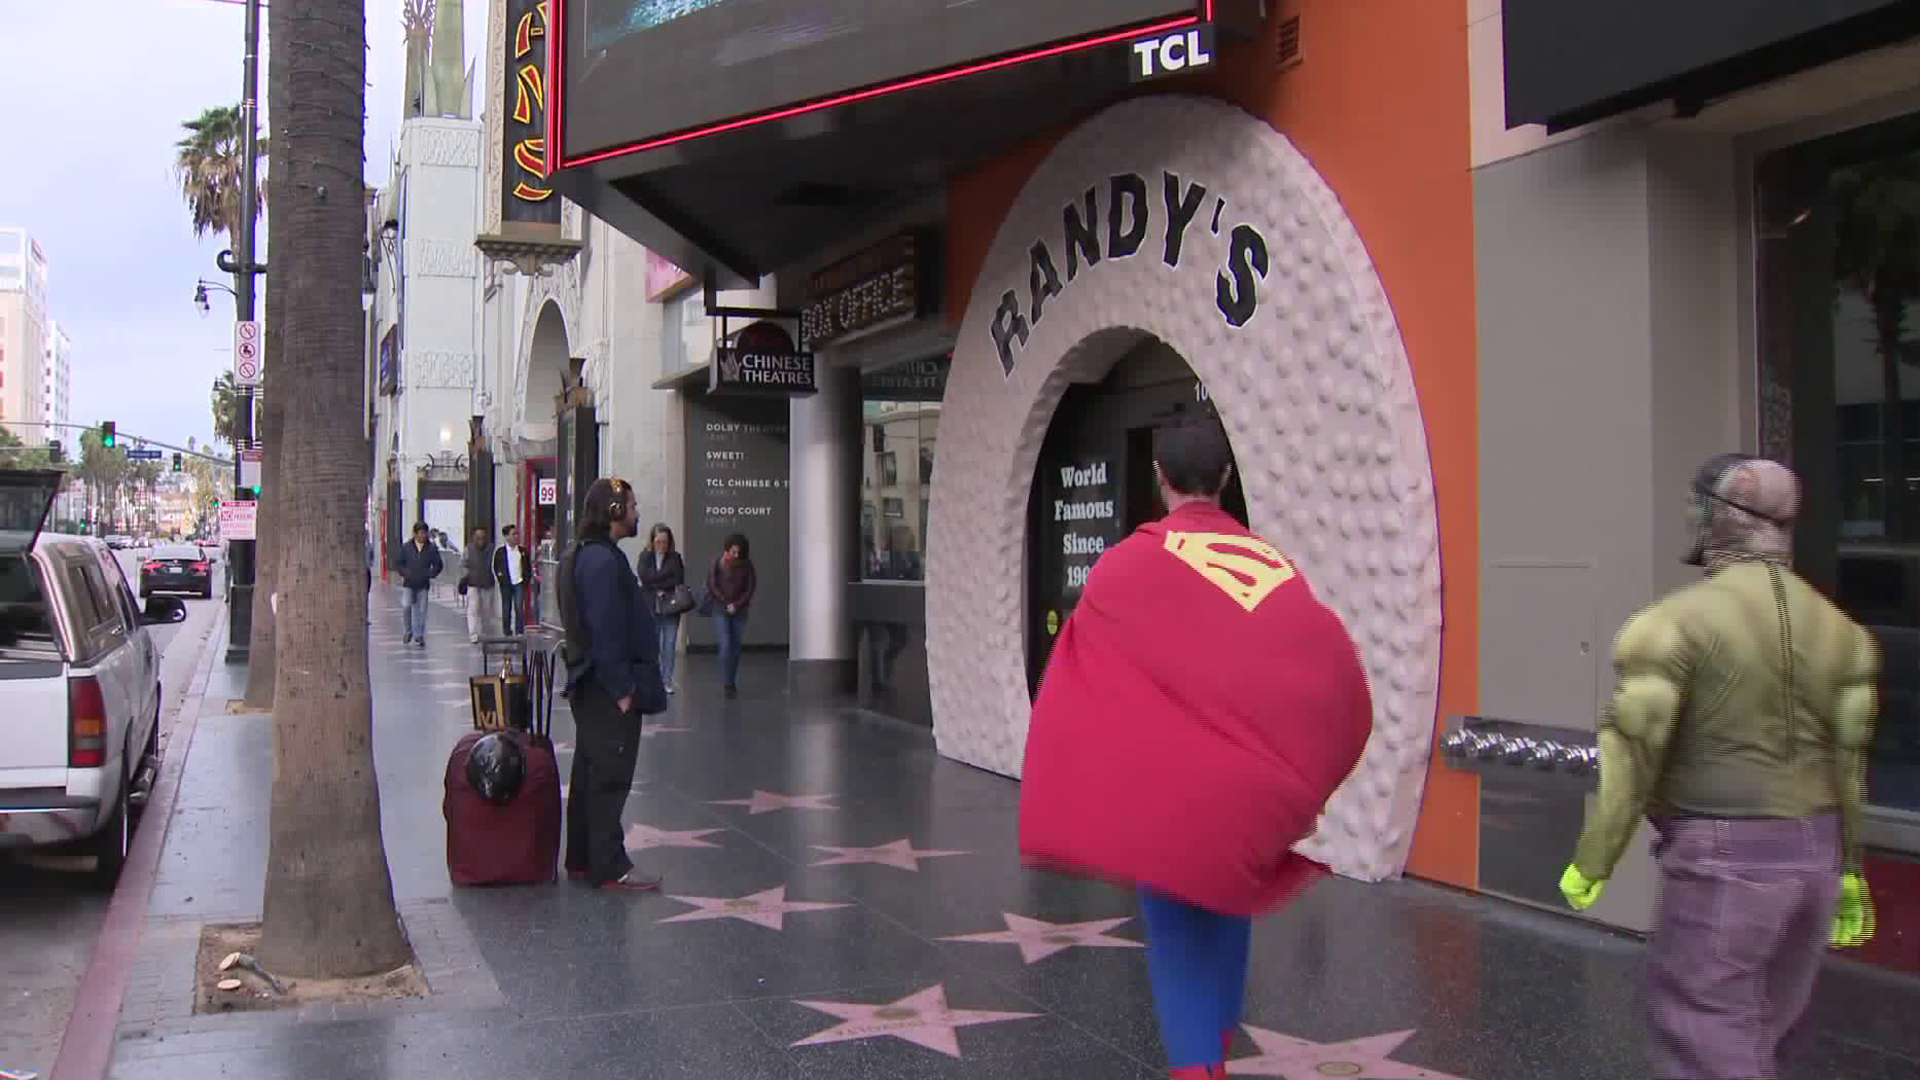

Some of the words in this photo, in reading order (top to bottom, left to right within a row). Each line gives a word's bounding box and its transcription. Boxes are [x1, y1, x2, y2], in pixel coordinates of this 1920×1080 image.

[1133, 30, 1210, 76] TCL
[990, 169, 1270, 378] RANDY'S
[801, 298, 833, 340] BOX
[840, 267, 905, 328] OFFICE
[742, 353, 812, 371] CHINESE
[742, 370, 812, 386] THEATRES
[706, 423, 740, 432] DOLBY
[706, 451, 744, 460] SWEET!
[706, 478, 725, 487] TCL
[728, 479, 771, 488] CHINESE
[1060, 462, 1107, 488] World
[706, 506, 735, 515] FOOD
[738, 507, 772, 516] COURT
[1054, 500, 1113, 521] Famous
[1062, 532, 1105, 555] Since
